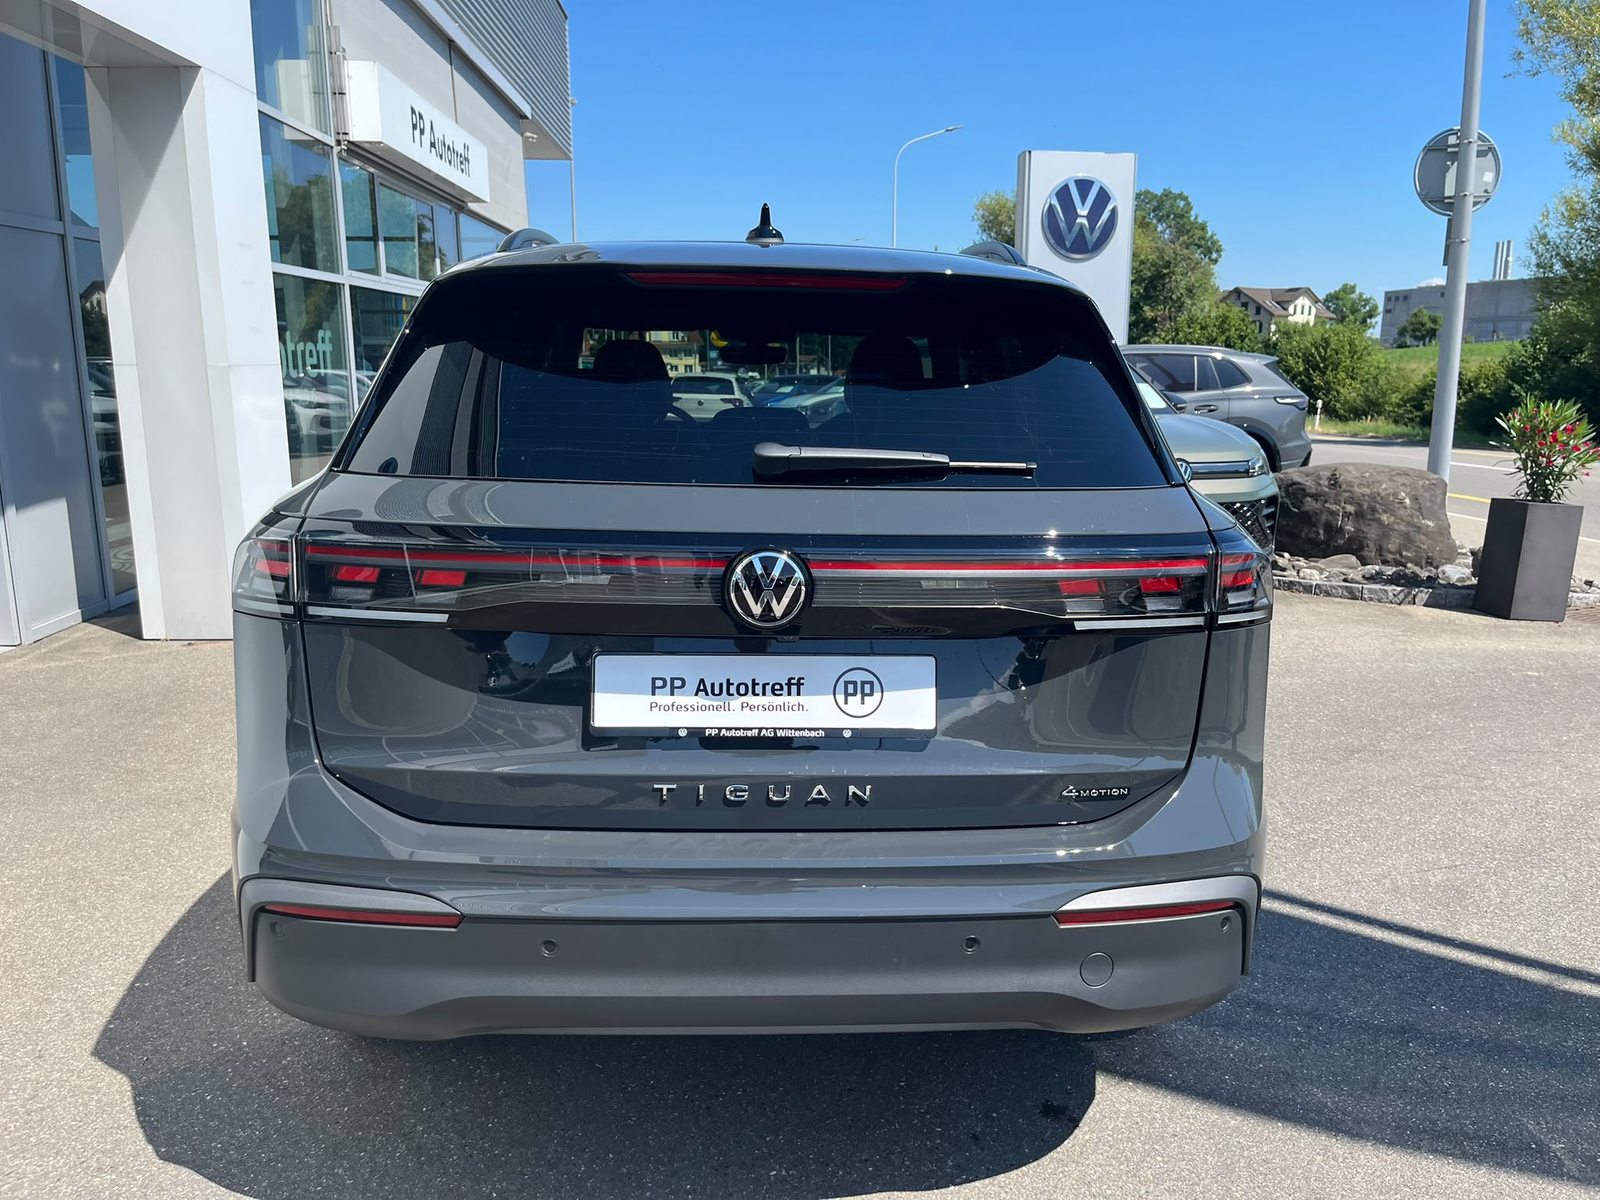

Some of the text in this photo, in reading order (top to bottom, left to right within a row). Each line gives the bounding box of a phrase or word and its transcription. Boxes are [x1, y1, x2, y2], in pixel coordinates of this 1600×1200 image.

[410, 105, 470, 177] PP Autotreff
[1045, 177, 1116, 257] VW
[731, 550, 806, 623] VW
[651, 677, 805, 697] PP Autotreff
[649, 701, 809, 712] Professionell. Persönlich.
[705, 728, 825, 738] PP Autotreff AG Wittenbach
[653, 784, 873, 802] TIGUAN
